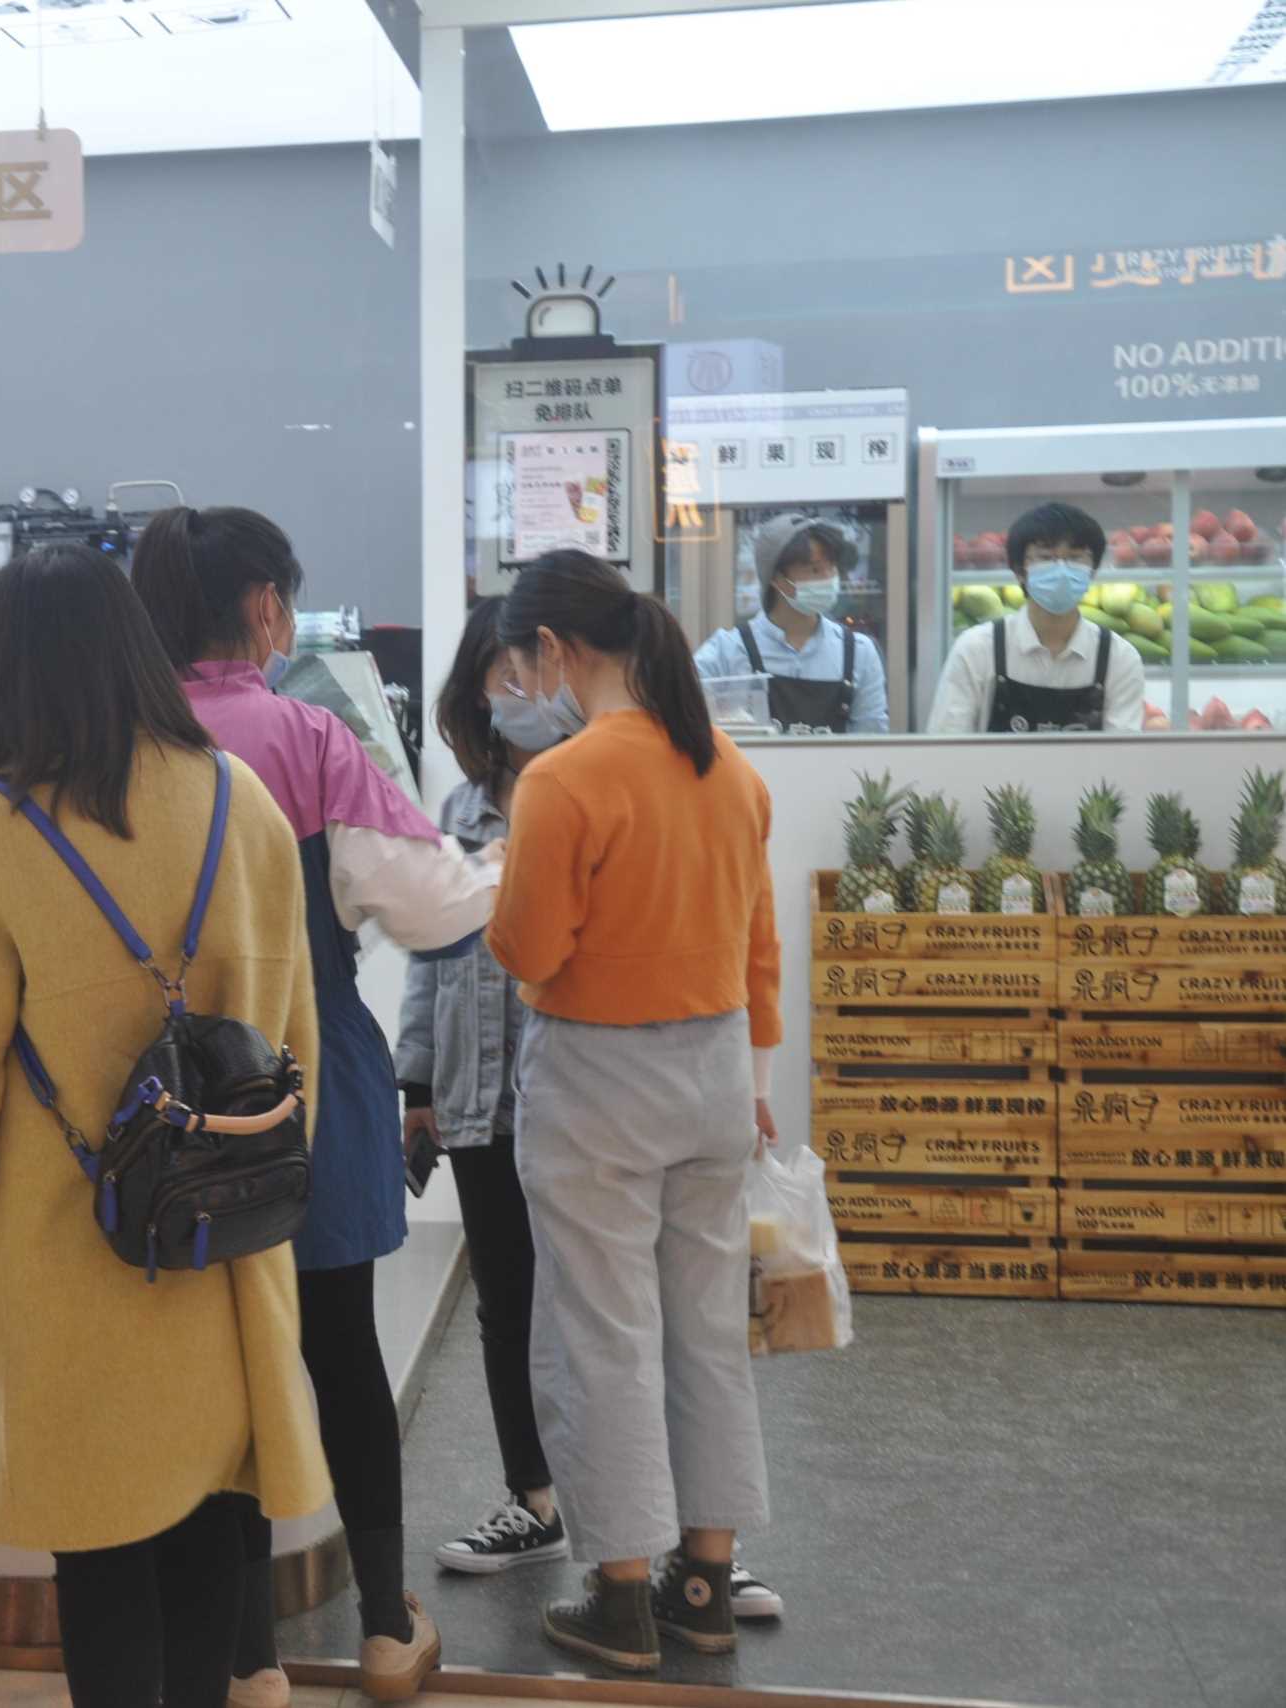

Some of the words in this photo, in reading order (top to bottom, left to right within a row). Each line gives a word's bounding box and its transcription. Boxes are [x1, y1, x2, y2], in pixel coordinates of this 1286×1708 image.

[1114, 343, 1163, 369] NO
[505, 376, 623, 398] 扫二维码点单
[535, 402, 593, 422] 免排队
[925, 926, 977, 938] CRAZY
[982, 926, 1041, 938] FRUITS
[1179, 929, 1232, 942] CRAZY
[925, 973, 977, 986] CRAZY
[982, 973, 1041, 986] FRUITS
[1179, 976, 1233, 990] CRAZY
[826, 1034, 844, 1046] NO
[848, 1034, 912, 1047] ADDITION
[1072, 1036, 1094, 1048] NO
[1097, 1036, 1163, 1048] ADDITION
[1179, 1099, 1233, 1112] CRAZY
[925, 1138, 977, 1151] CRAZY
[982, 1138, 1041, 1152] FRUITS
[849, 1196, 912, 1209] ADDITION
[1075, 1206, 1098, 1217] NO
[1099, 1206, 1164, 1218] ADDITION
